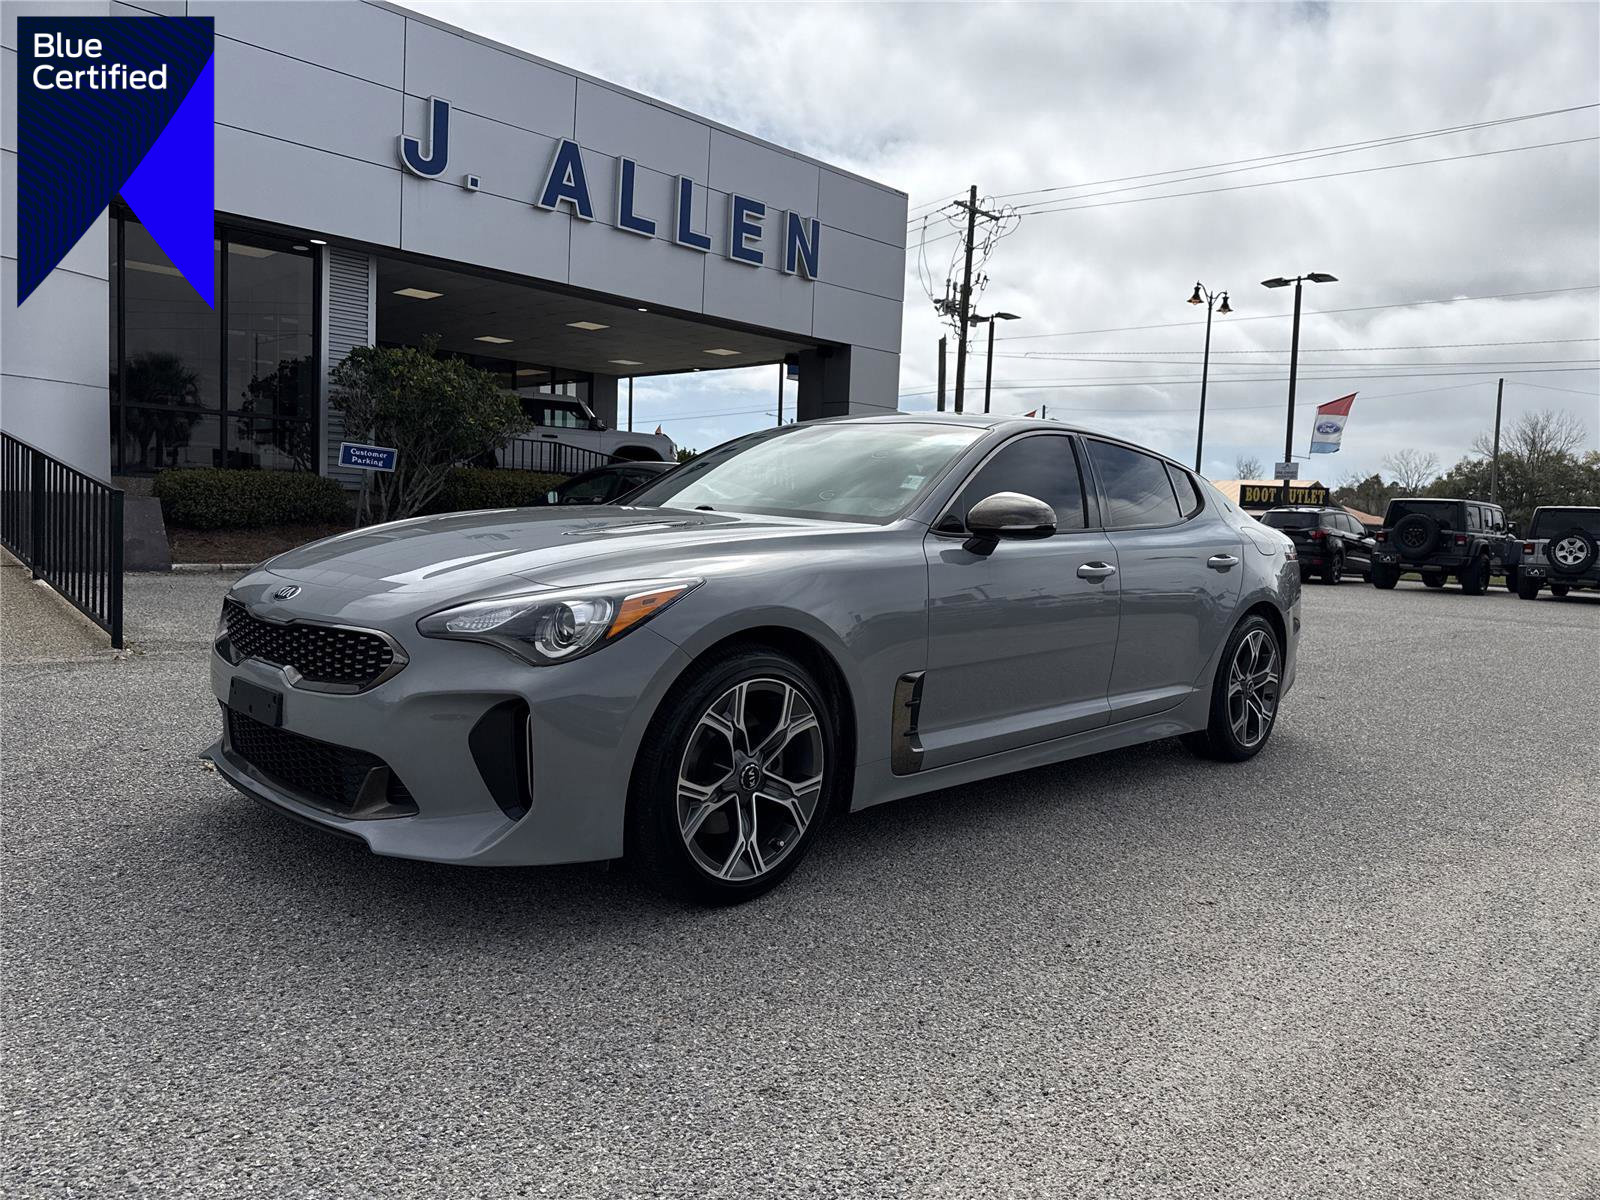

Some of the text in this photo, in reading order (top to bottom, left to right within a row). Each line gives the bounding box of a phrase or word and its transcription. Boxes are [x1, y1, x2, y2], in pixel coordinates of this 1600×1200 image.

[398, 96, 821, 281] J. ALLEN
[350, 448, 388, 459] Customer
[351, 456, 384, 467] Parking
[1245, 487, 1326, 505] BOOT UTLET
